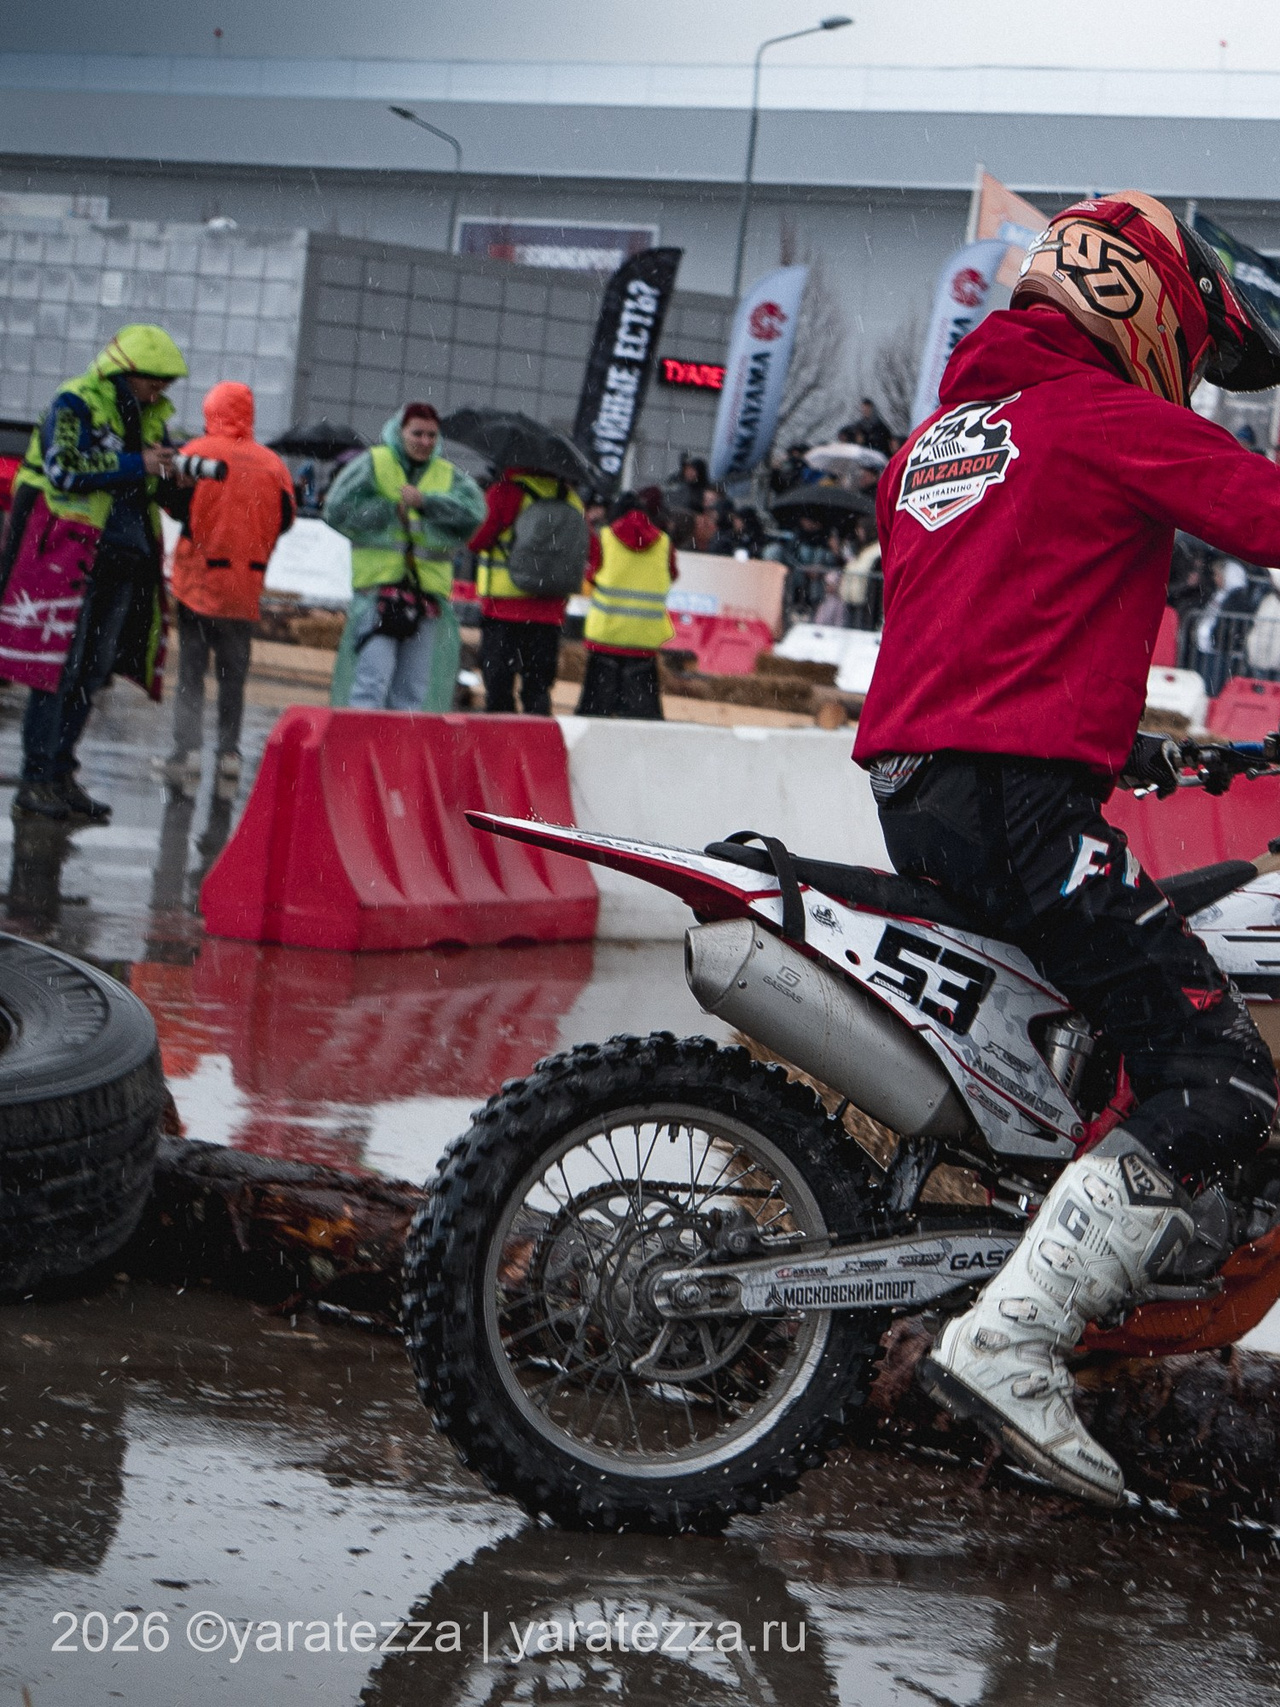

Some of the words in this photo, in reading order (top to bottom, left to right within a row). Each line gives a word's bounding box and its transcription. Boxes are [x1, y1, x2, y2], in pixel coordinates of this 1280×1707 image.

[613, 279, 661, 361] ЕСТЬ?
[662, 358, 726, 389] ТУАЛЕ
[911, 453, 999, 488] NAZAROV
[932, 483, 972, 497] TRAINING
[763, 975, 802, 1004] GASGAS
[867, 924, 996, 1036] 53
[950, 1248, 1014, 1271] GAS
[784, 1279, 874, 1307] МОСКОВСКИЙ
[876, 1279, 917, 1301] СПОРТ
